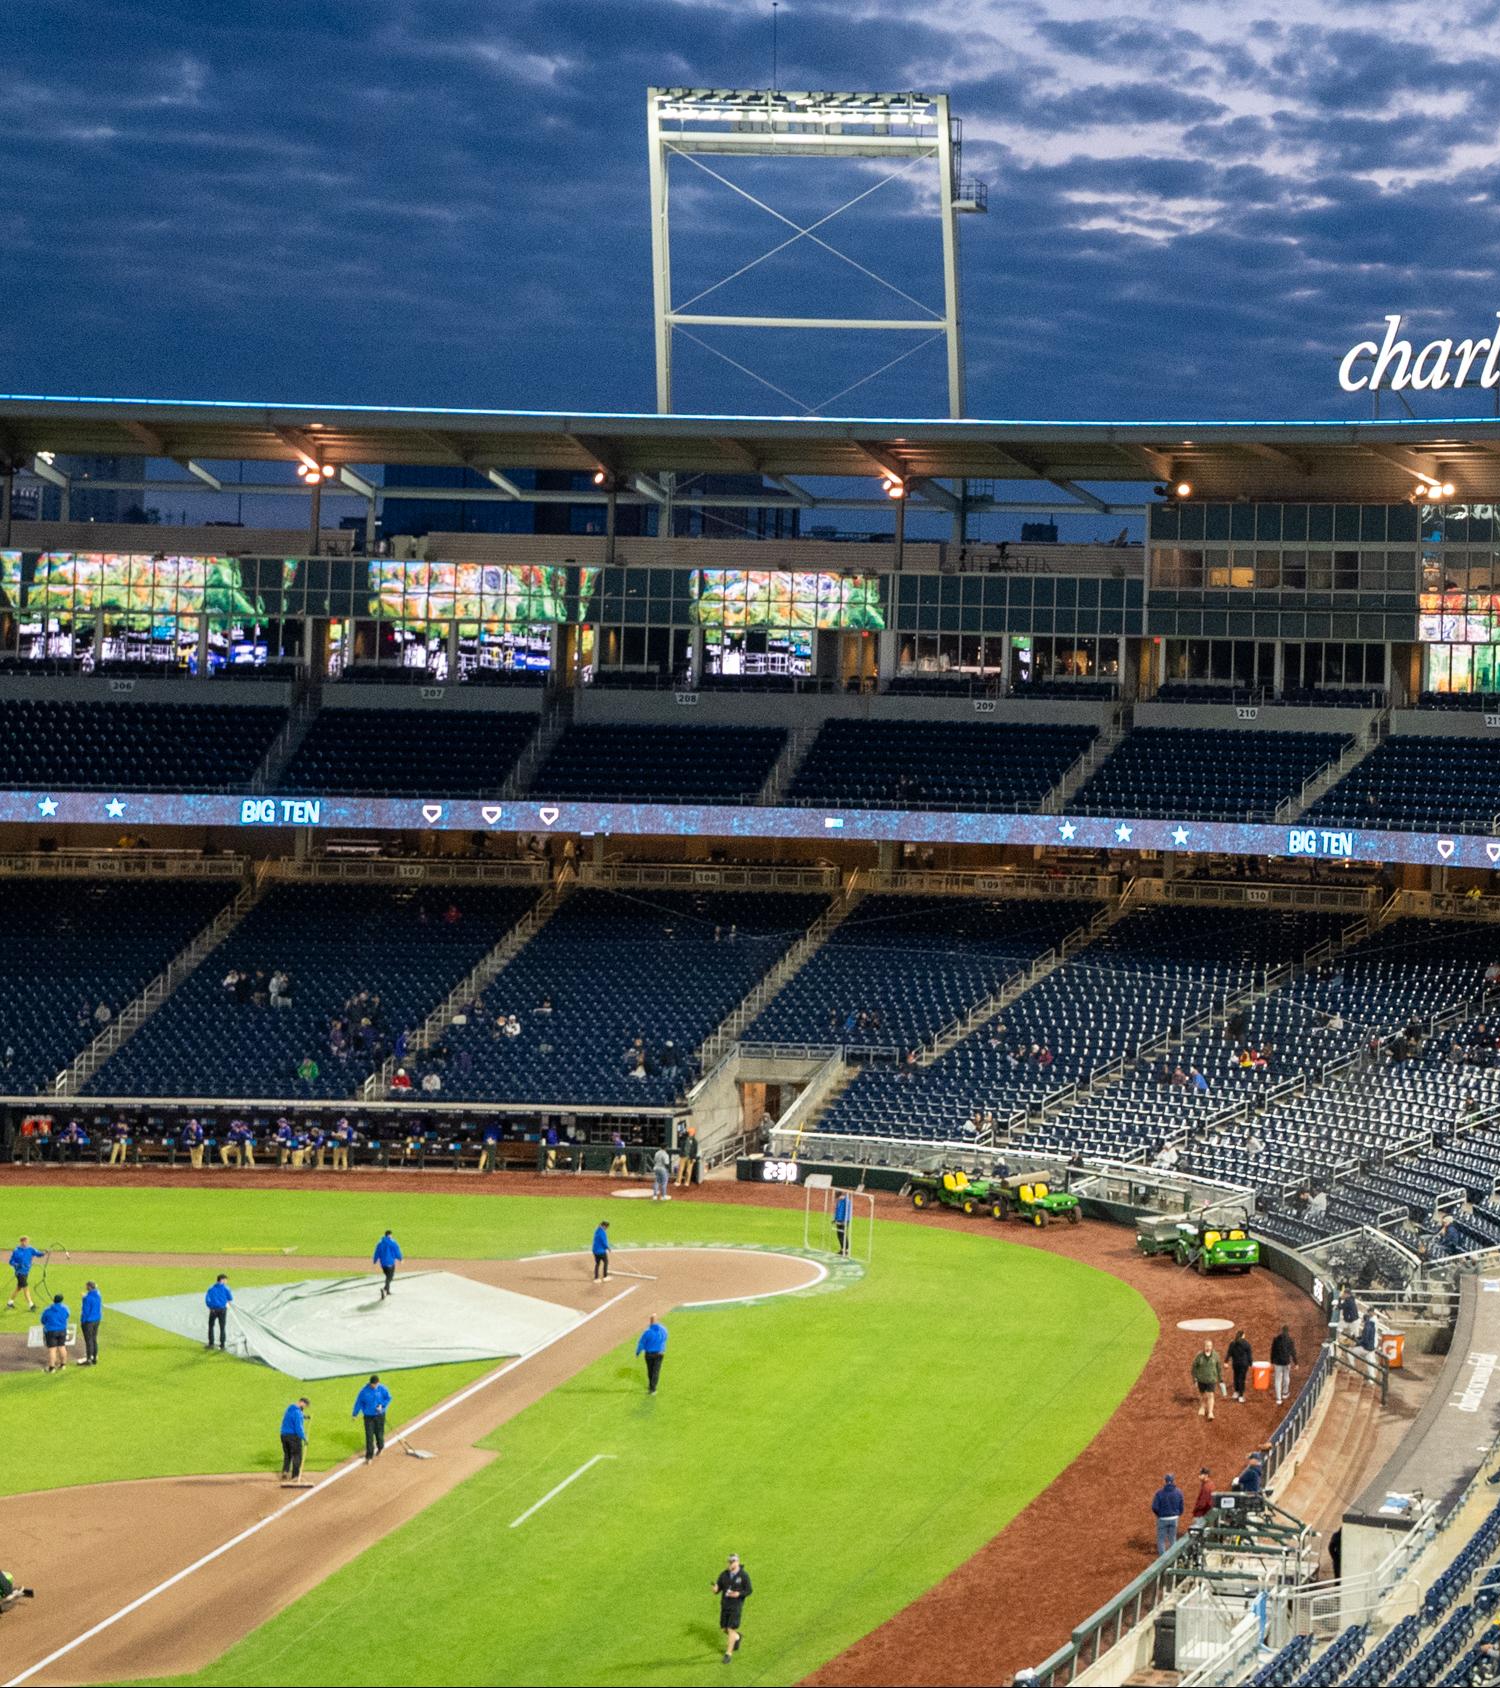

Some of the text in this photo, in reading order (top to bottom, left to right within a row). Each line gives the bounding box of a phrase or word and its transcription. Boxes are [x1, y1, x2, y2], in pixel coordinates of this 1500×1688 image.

[113, 681, 132, 690] 206
[423, 689, 442, 697] 207
[678, 694, 697, 703] 208
[976, 702, 994, 711] 209
[1238, 709, 1256, 718] 210
[241, 799, 320, 824] BIG TEN
[1289, 830, 1353, 856] BIG TEN
[403, 868, 420, 876] 107
[982, 881, 999, 889] 109
[1250, 892, 1266, 900] 110
[763, 1161, 797, 1181] 2:30
